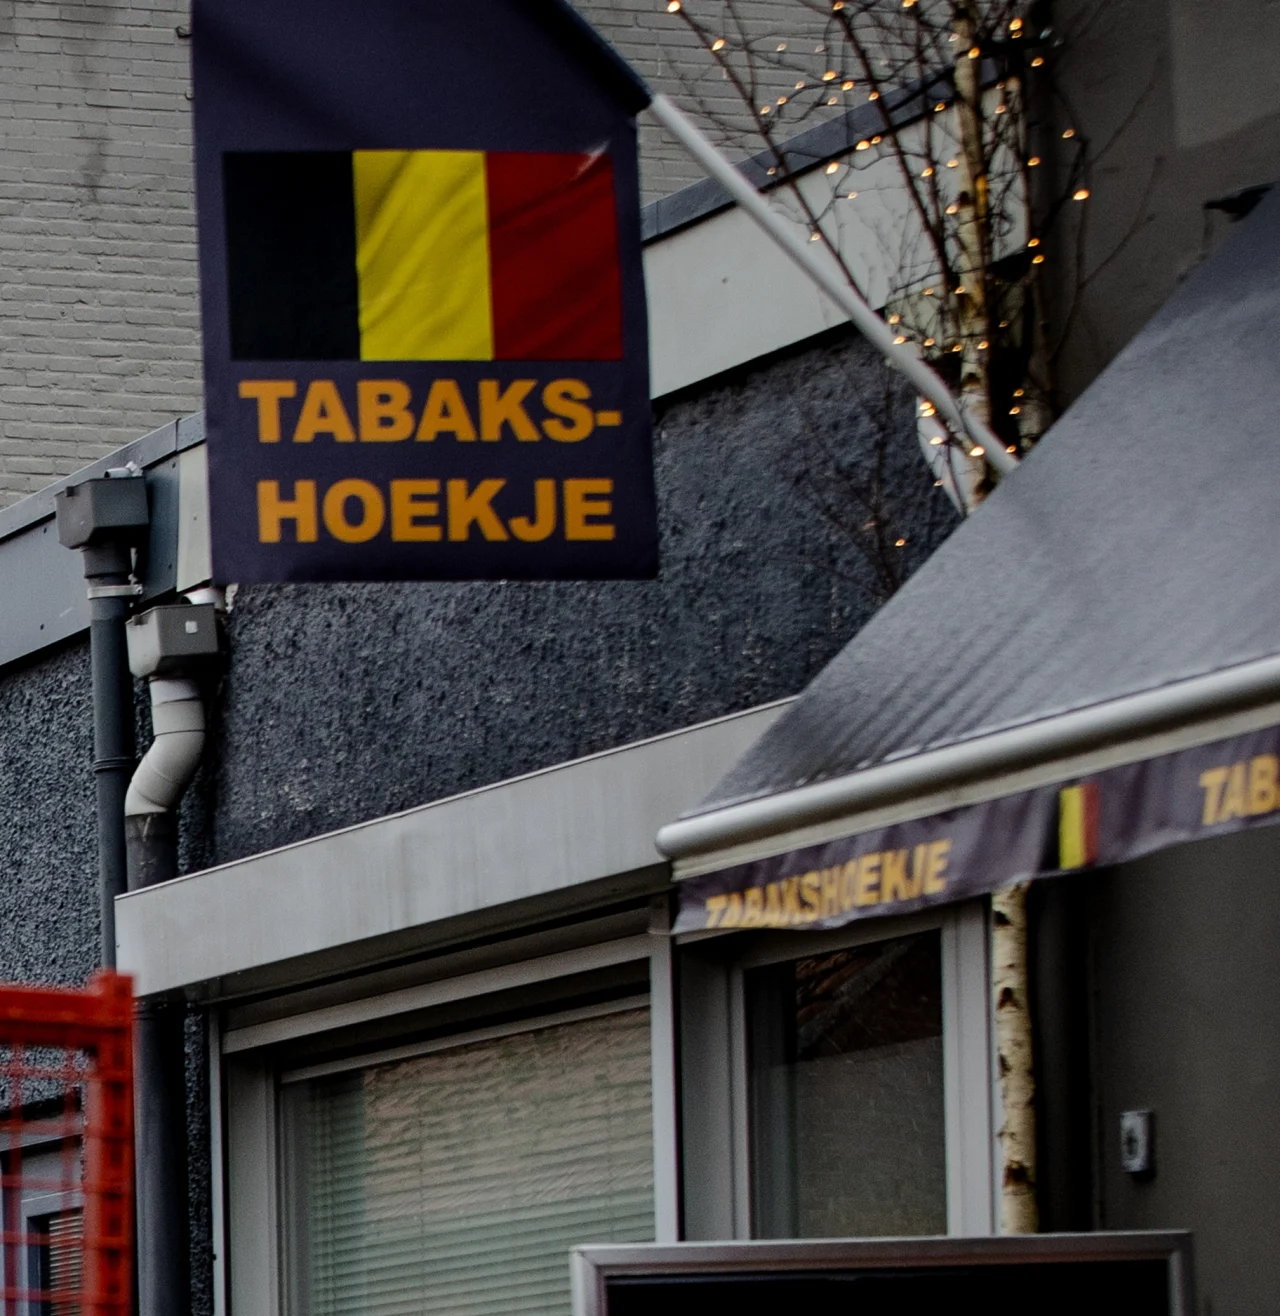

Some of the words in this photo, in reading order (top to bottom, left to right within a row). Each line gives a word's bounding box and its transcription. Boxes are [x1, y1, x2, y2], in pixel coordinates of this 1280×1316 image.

[239, 378, 623, 444] TABAKS-
[256, 478, 617, 543] HOEKJE
[1199, 754, 1280, 825] TAB
